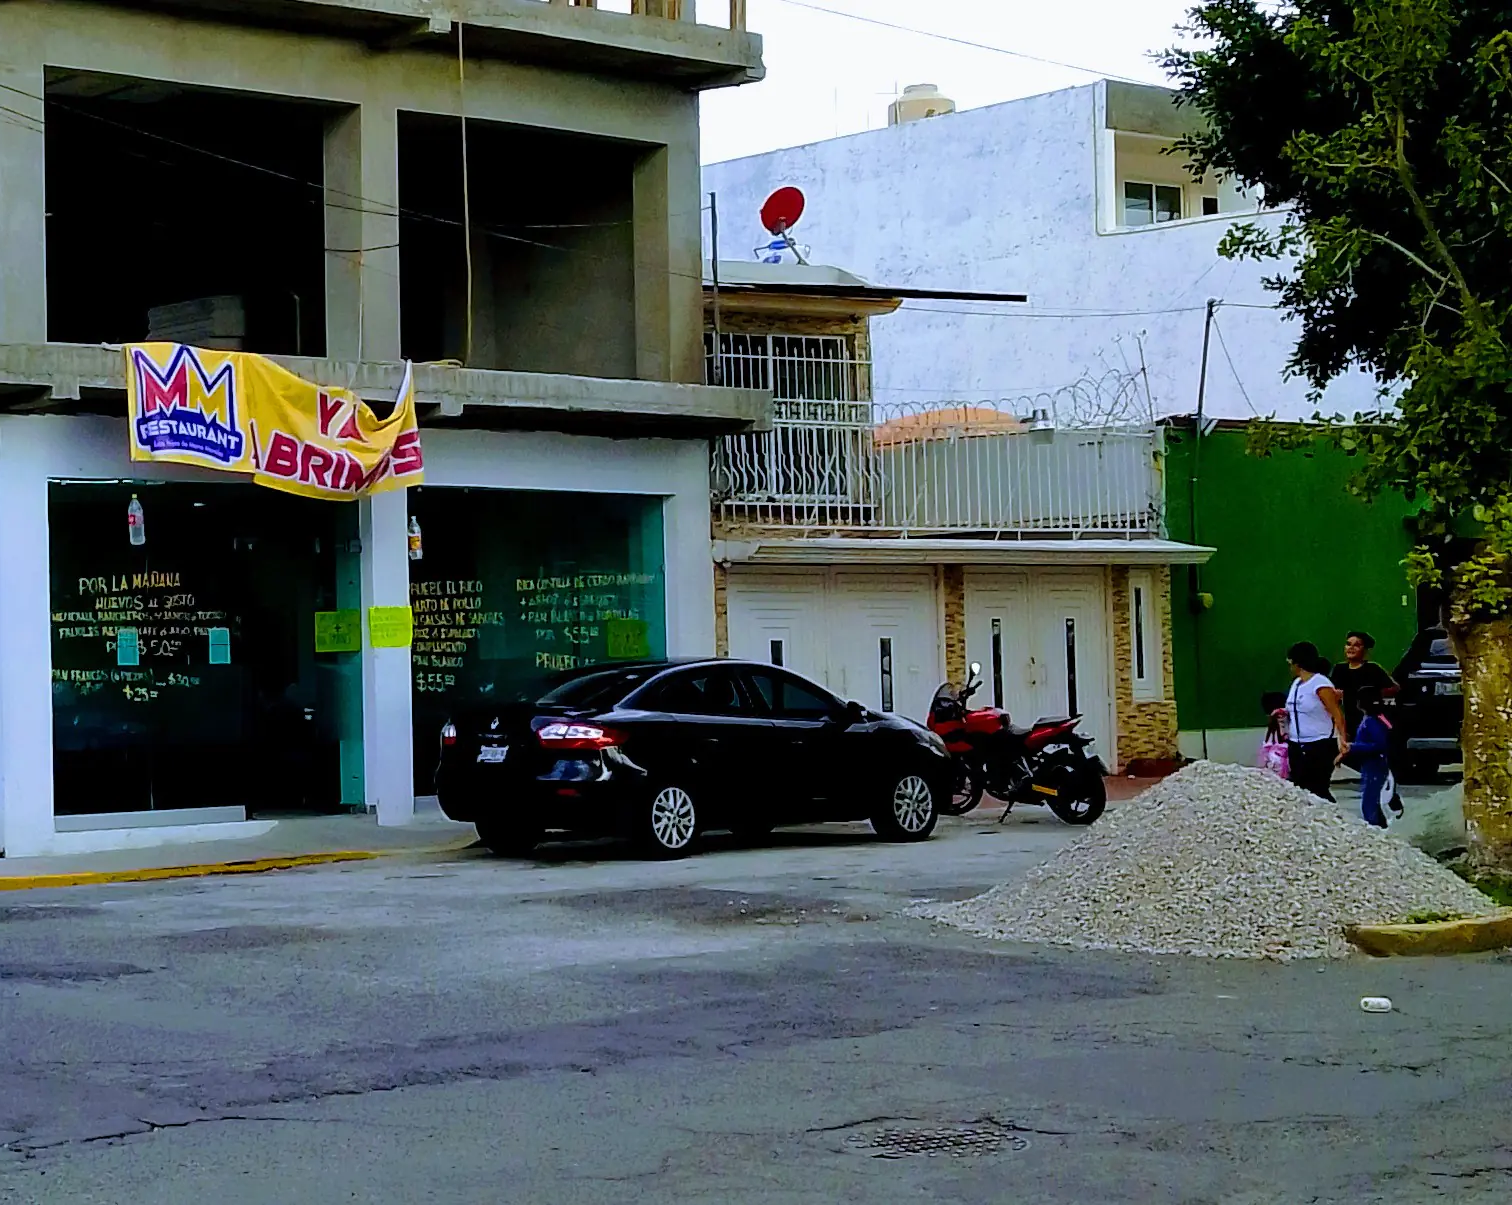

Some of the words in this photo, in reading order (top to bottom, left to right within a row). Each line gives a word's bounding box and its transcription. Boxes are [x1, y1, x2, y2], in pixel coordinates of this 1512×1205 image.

[140, 419, 240, 450] RESTAURANT
[316, 391, 368, 443] YA
[249, 419, 424, 491] BRIMS
[78, 576, 107, 595] POR
[112, 575, 128, 591] LA
